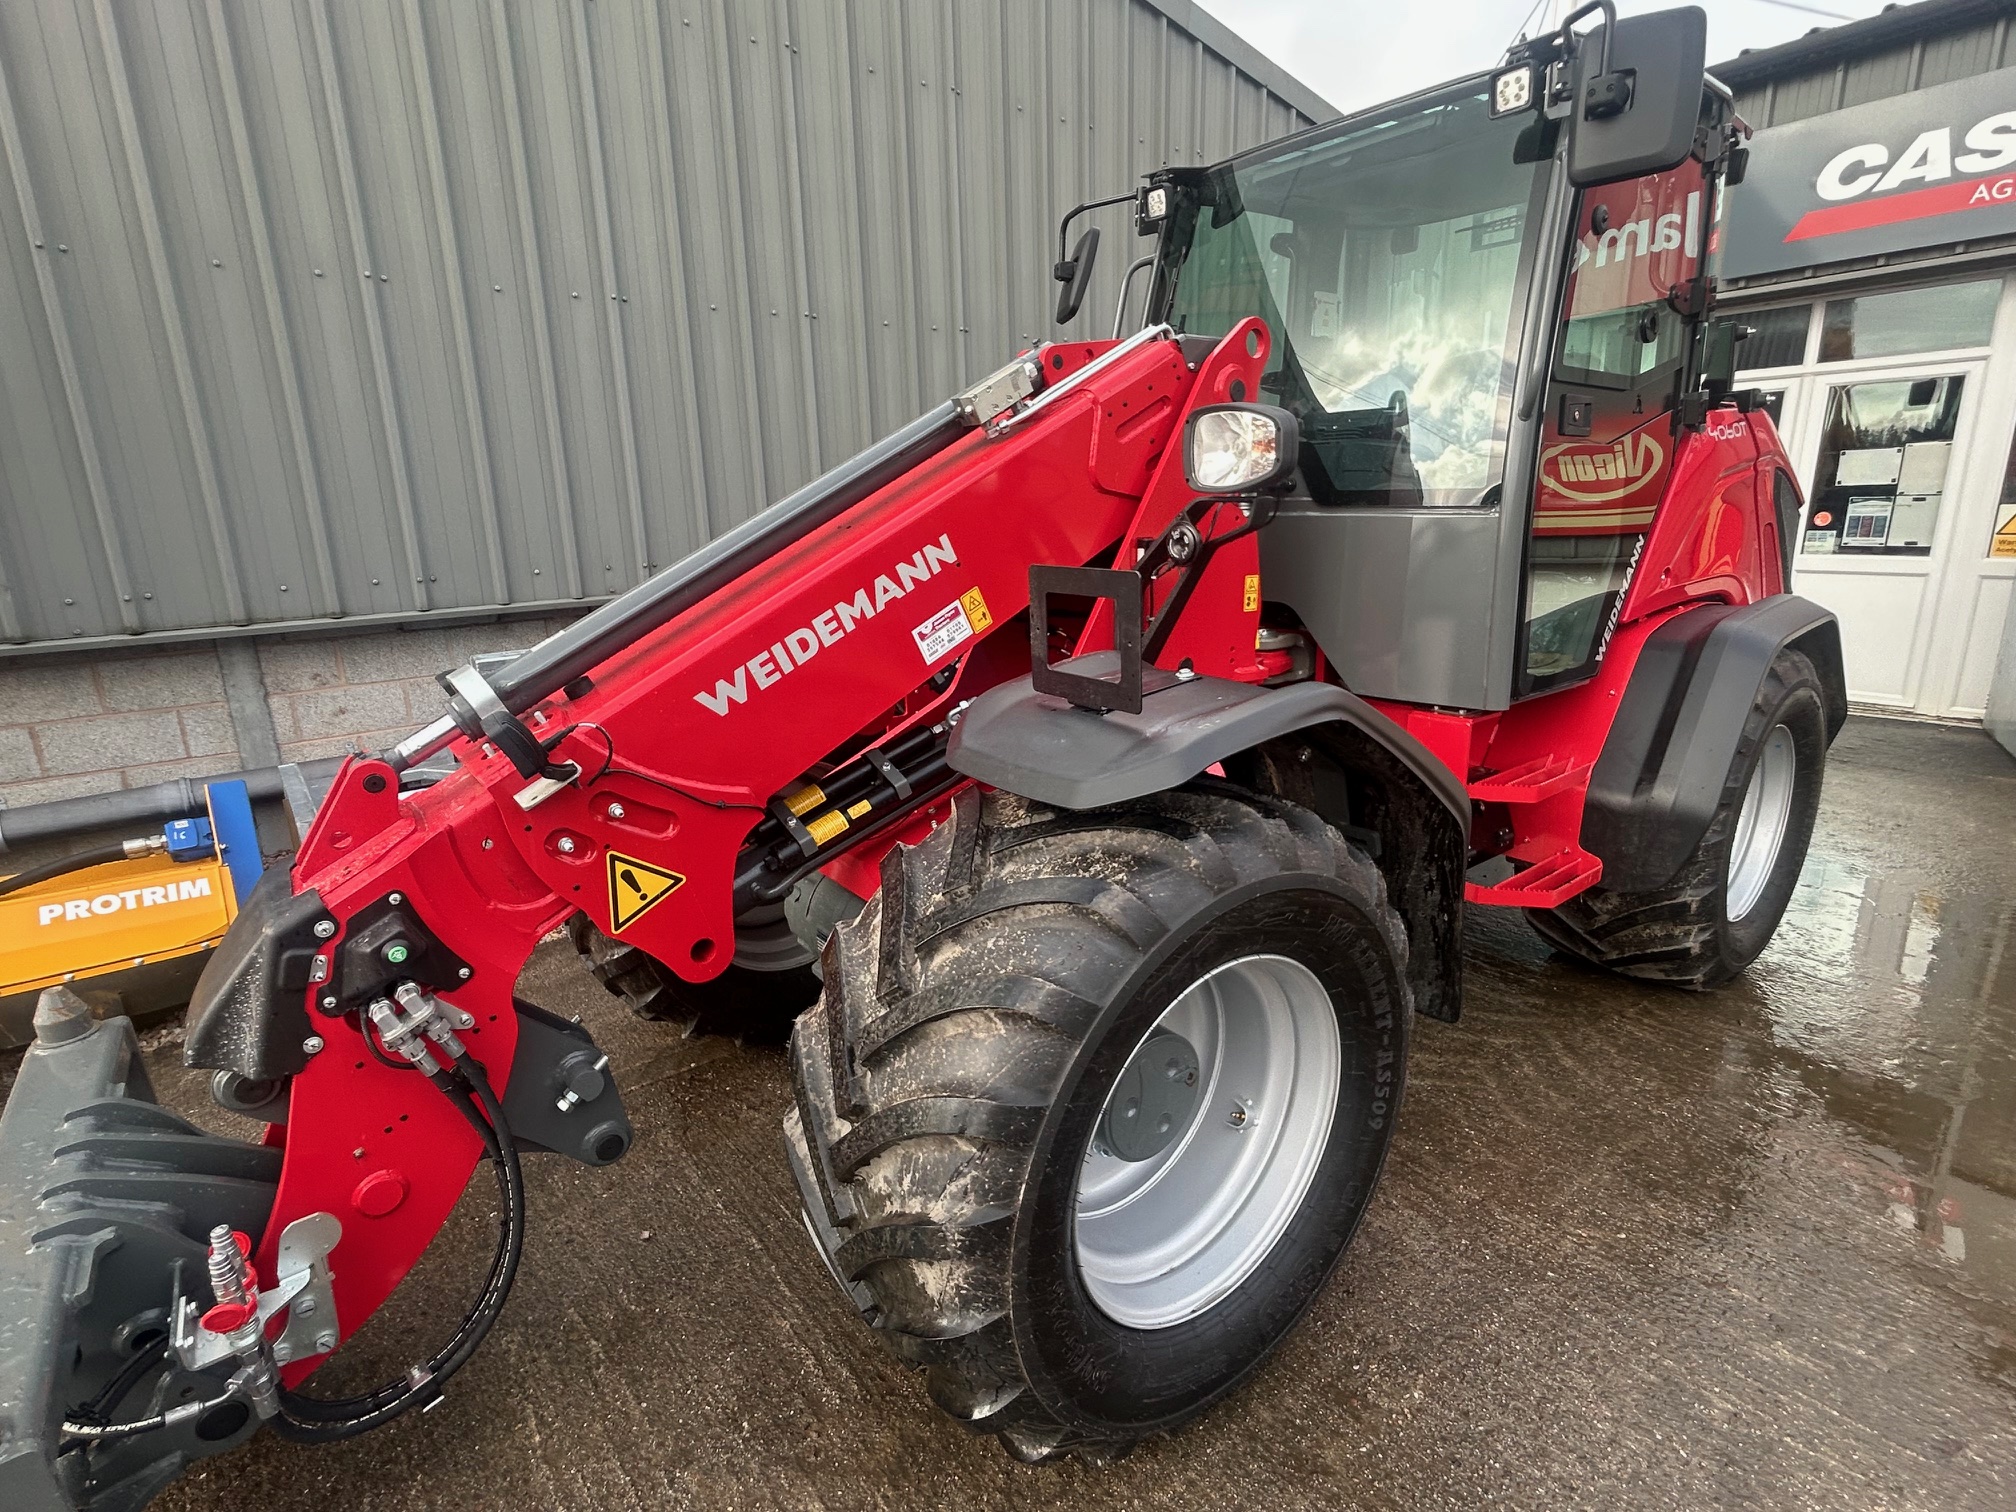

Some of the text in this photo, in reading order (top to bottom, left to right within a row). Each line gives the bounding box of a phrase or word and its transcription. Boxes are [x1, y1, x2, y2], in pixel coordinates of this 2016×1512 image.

[1969, 179, 2016, 204] AG
[693, 533, 958, 716] WEIDEMANN
[1595, 534, 1644, 662] WEIDEMANN
[38, 877, 211, 925] PROTRIM
